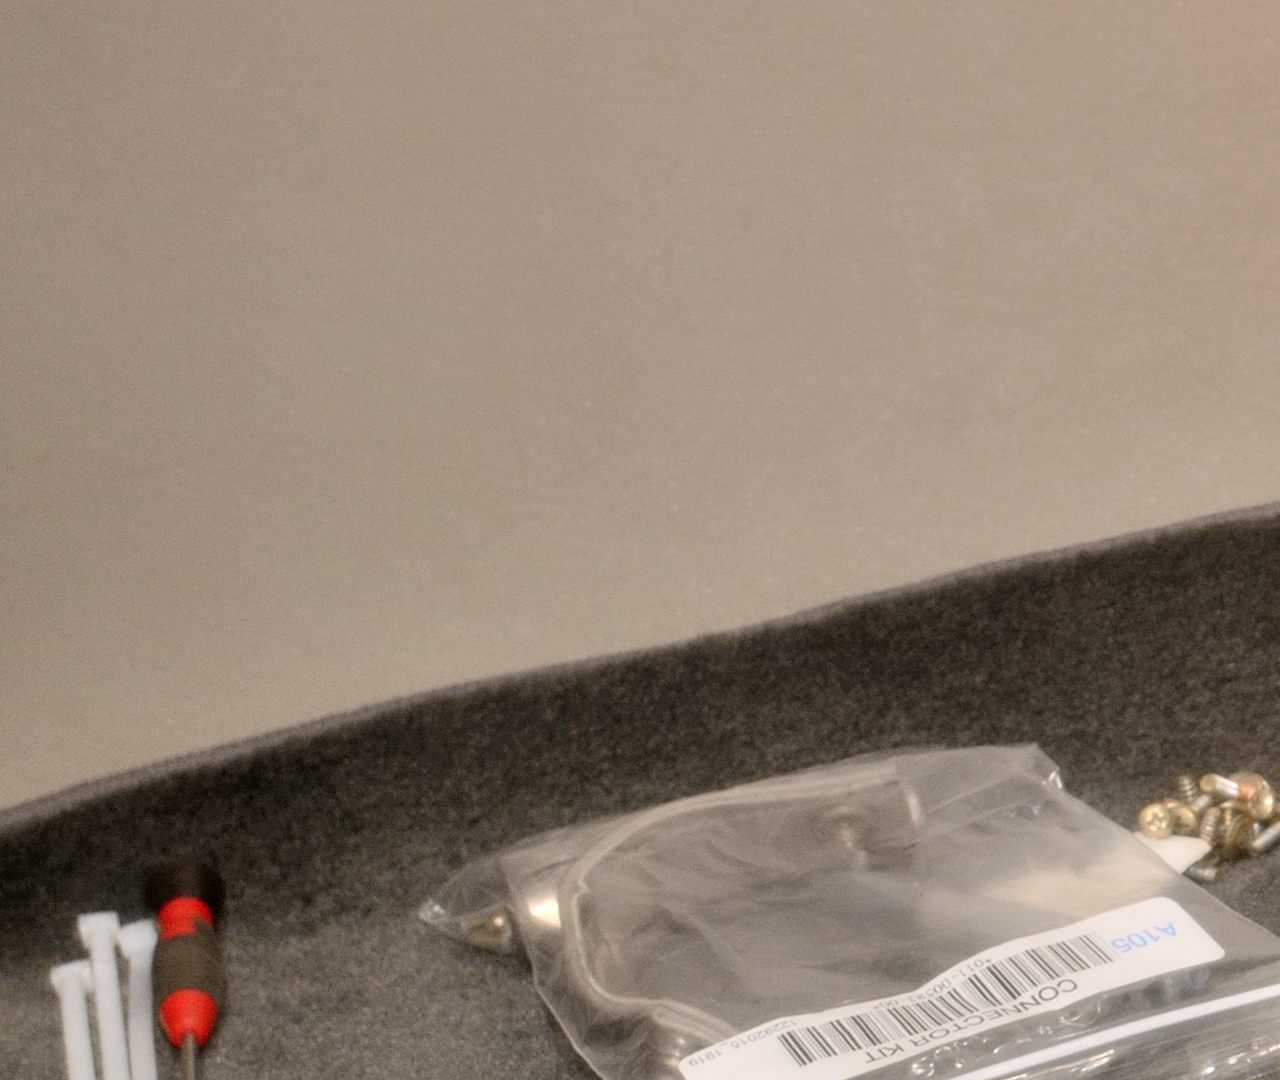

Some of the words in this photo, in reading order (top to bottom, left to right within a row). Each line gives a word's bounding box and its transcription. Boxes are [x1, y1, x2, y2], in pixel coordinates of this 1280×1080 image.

[1111, 921, 1177, 953] A105
[910, 978, 1078, 1047] CONNECTOR
[866, 1043, 905, 1064] KIT
